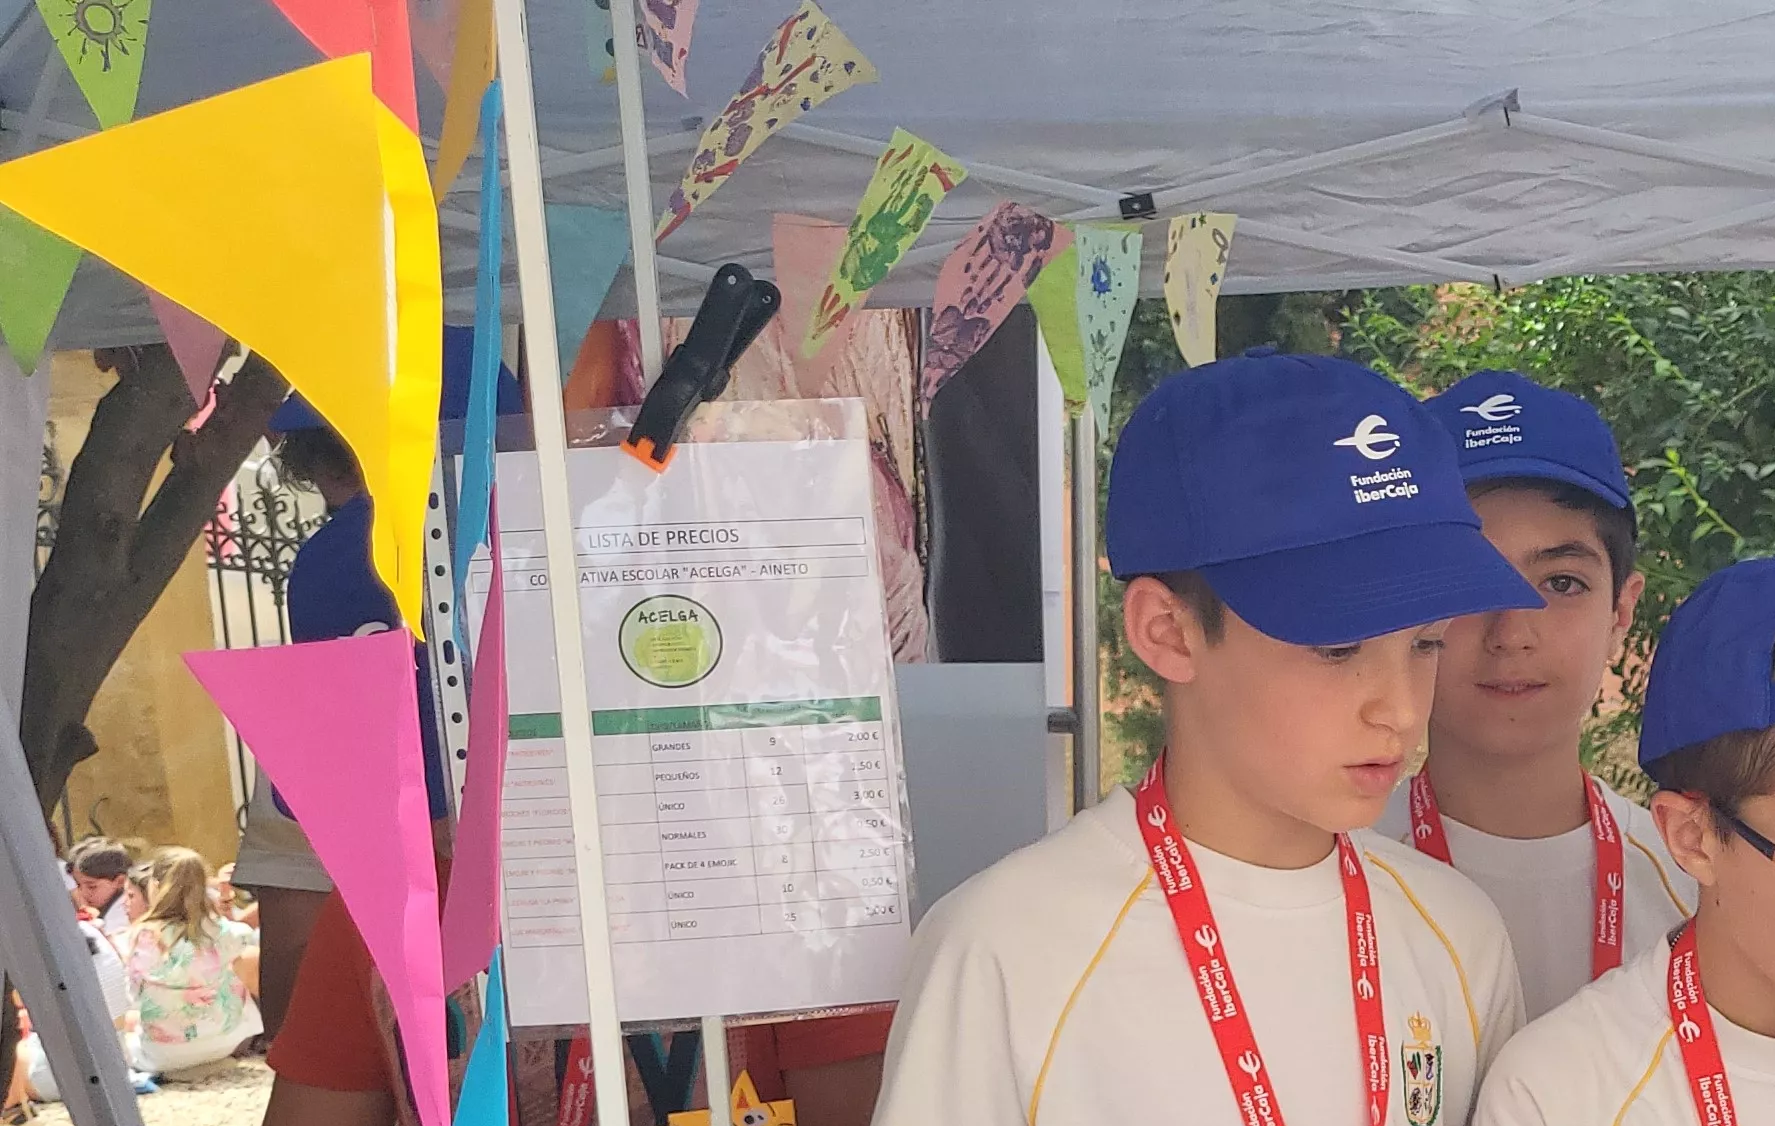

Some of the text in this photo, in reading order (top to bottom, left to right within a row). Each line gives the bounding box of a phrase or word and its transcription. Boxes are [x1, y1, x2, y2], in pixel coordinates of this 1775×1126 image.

[1466, 425, 1521, 438] Fundación
[1465, 434, 1522, 449] iberCaja
[1350, 468, 1412, 487] Fundación
[1354, 482, 1419, 504] iberCaja
[589, 528, 740, 549] LISTA DE PRECIOS
[529, 569, 618, 587] COATIVA
[622, 568, 680, 581] ESCOLAR
[683, 564, 747, 579] "ACELGA"
[760, 563, 809, 576] AINETO
[638, 609, 699, 625] ACELGA
[652, 742, 691, 752] GRANDES
[768, 737, 776, 746] 9
[655, 771, 701, 781] PEQUEÑOS
[770, 767, 782, 776] 12
[658, 801, 685, 811] ÚNICO
[661, 831, 707, 841] NORMALES
[1153, 845, 1179, 896] Fundación
[667, 890, 695, 900] ÚNICO
[671, 919, 698, 929] ÚNICO
[1684, 951, 1698, 1005] Fundación
[1198, 965, 1224, 1023] Fundación
